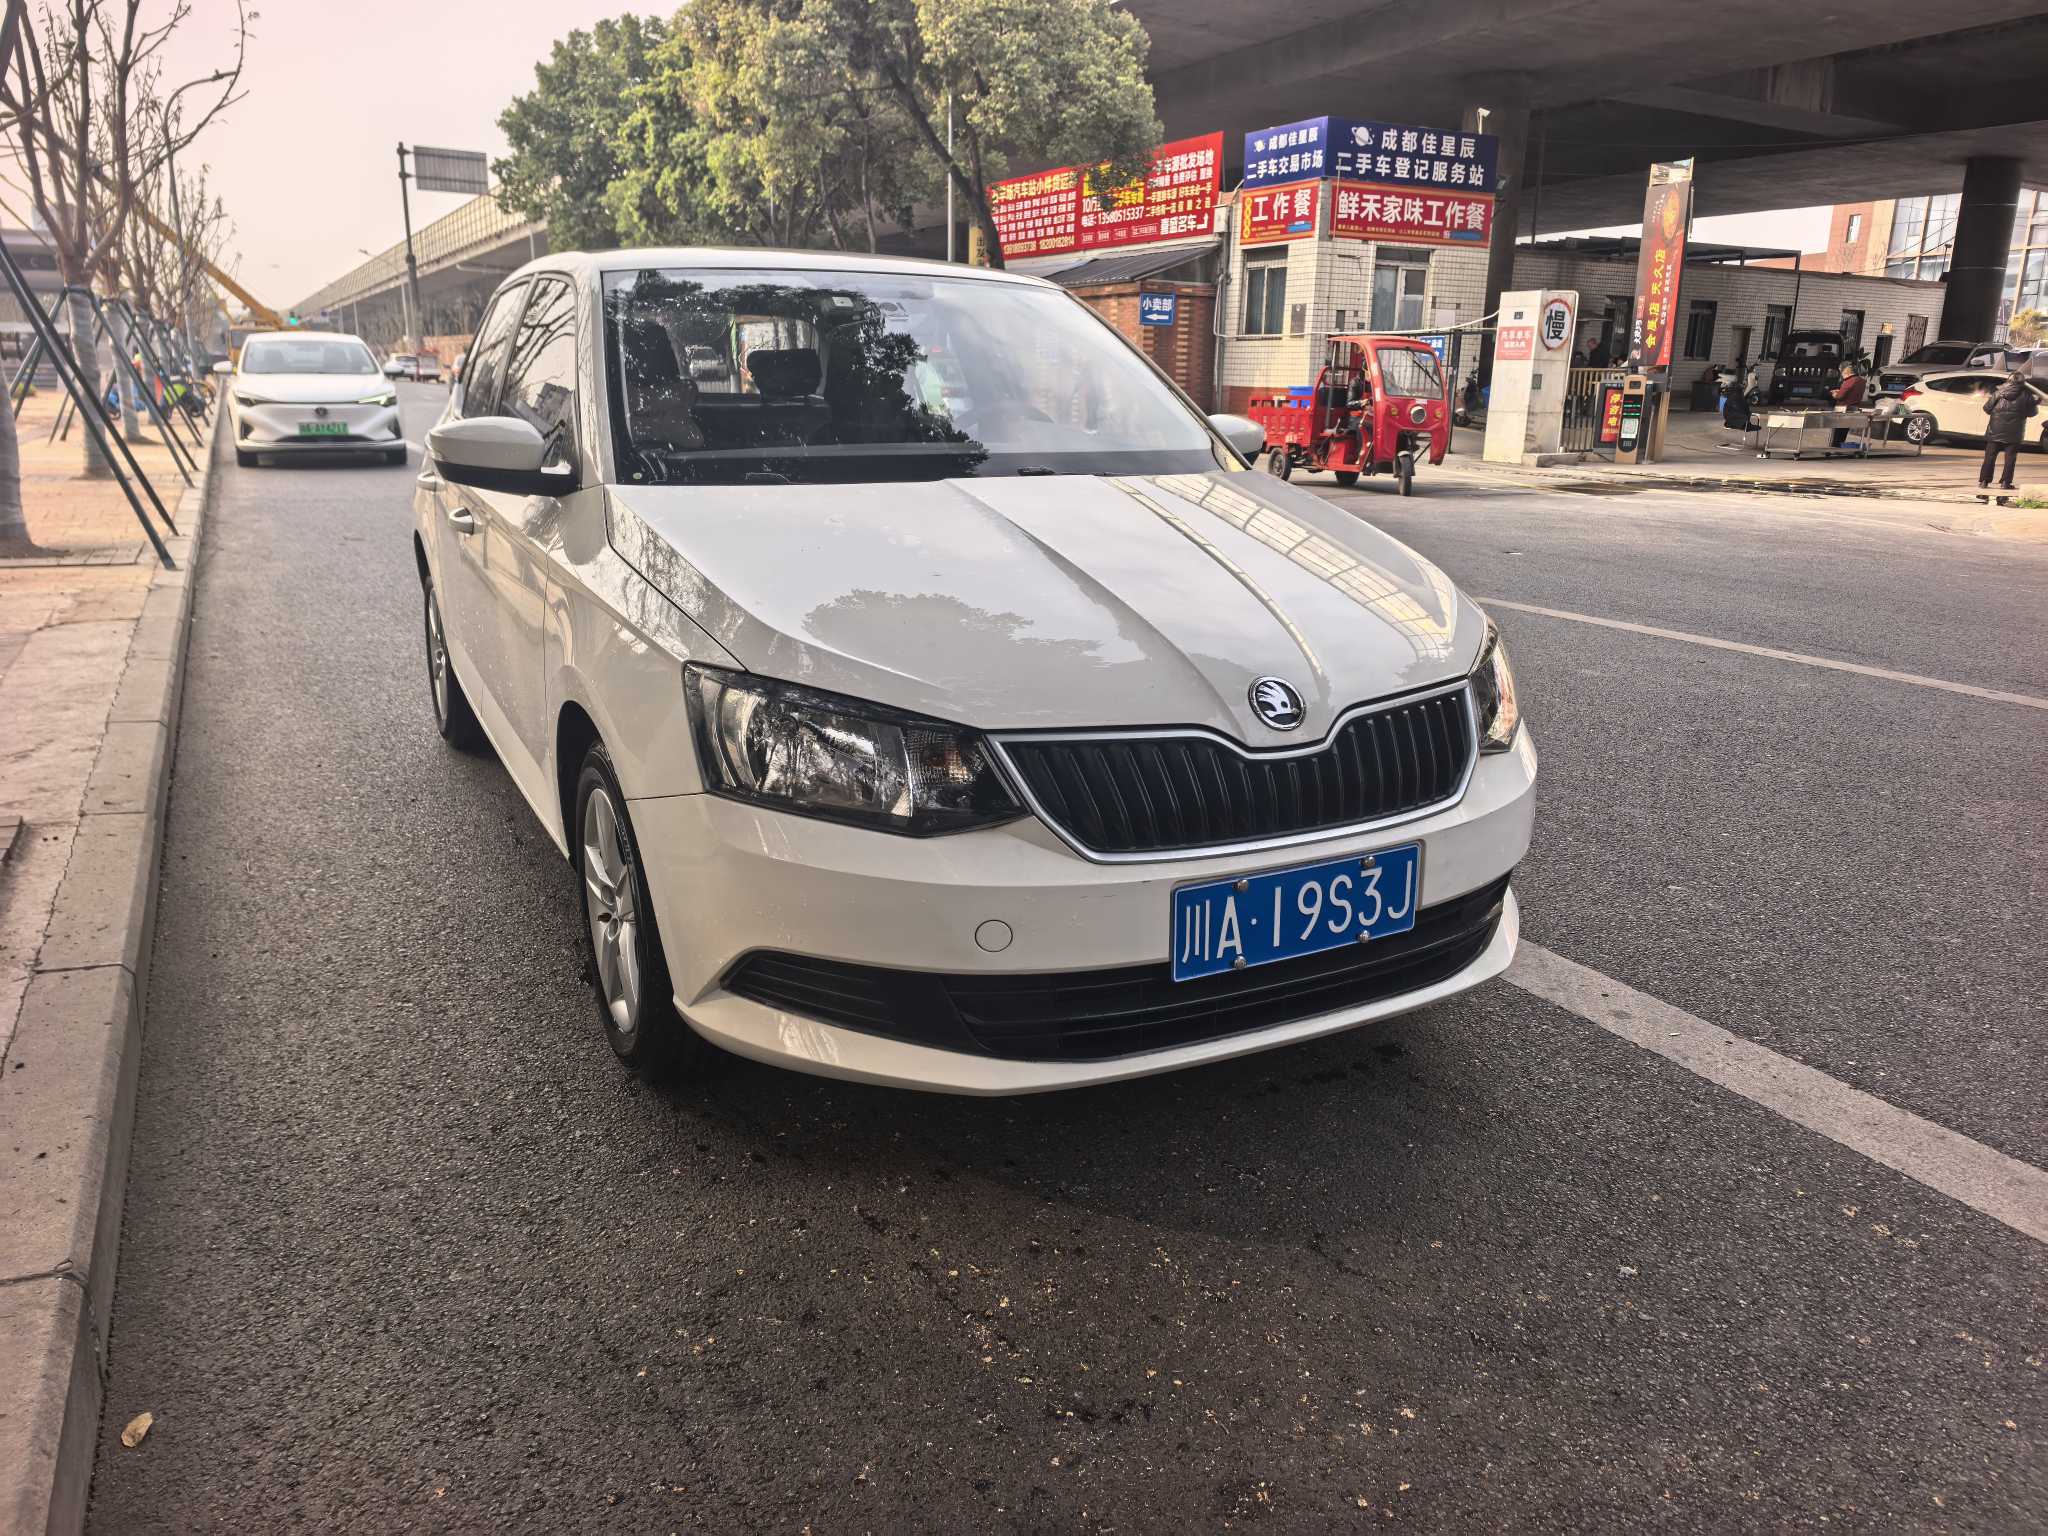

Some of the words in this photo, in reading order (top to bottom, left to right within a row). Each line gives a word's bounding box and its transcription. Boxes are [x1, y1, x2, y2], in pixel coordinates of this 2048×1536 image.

[1268, 127, 1318, 151] 成都佳星辰
[1381, 130, 1476, 159] 成都佳星辰
[1247, 150, 1323, 180] 二手车交易市场
[1336, 152, 1485, 187] 二手车登记服务站
[1252, 189, 1311, 221] 工作餐
[1337, 190, 1486, 231] 鲜禾家味工作餐
[1143, 296, 1173, 312] 小卖部
[1546, 309, 1565, 340] 慢
[1181, 860, 1413, 964] 川A·19S3J
